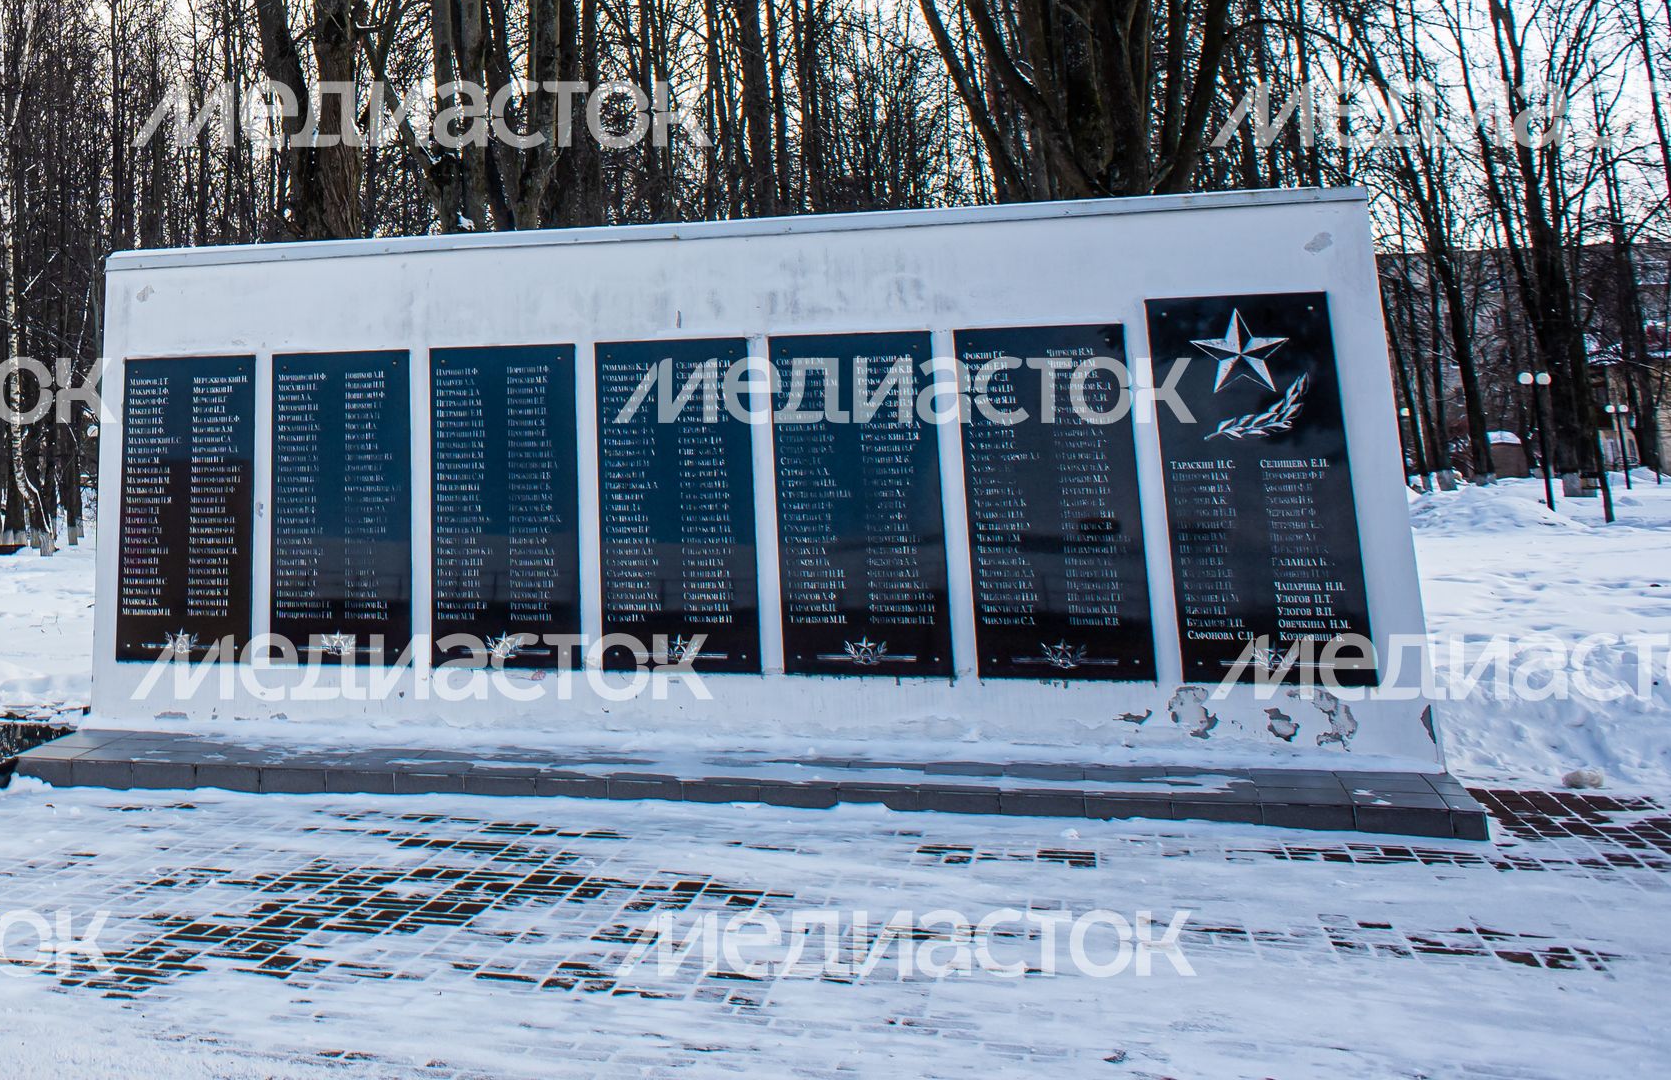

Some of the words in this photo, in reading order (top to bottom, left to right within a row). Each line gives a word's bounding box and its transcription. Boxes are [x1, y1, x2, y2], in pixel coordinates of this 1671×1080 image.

[1170, 460, 1214, 469] ТАРАСКИН
[1274, 582, 1321, 590] ЧАПАРИНА
[1275, 594, 1310, 603] УЛОГОВ
[1277, 607, 1312, 616] УЛОГОВ
[1278, 619, 1326, 628] ОВЕЧКИНА
[1188, 631, 1234, 640] САФОНОВА
